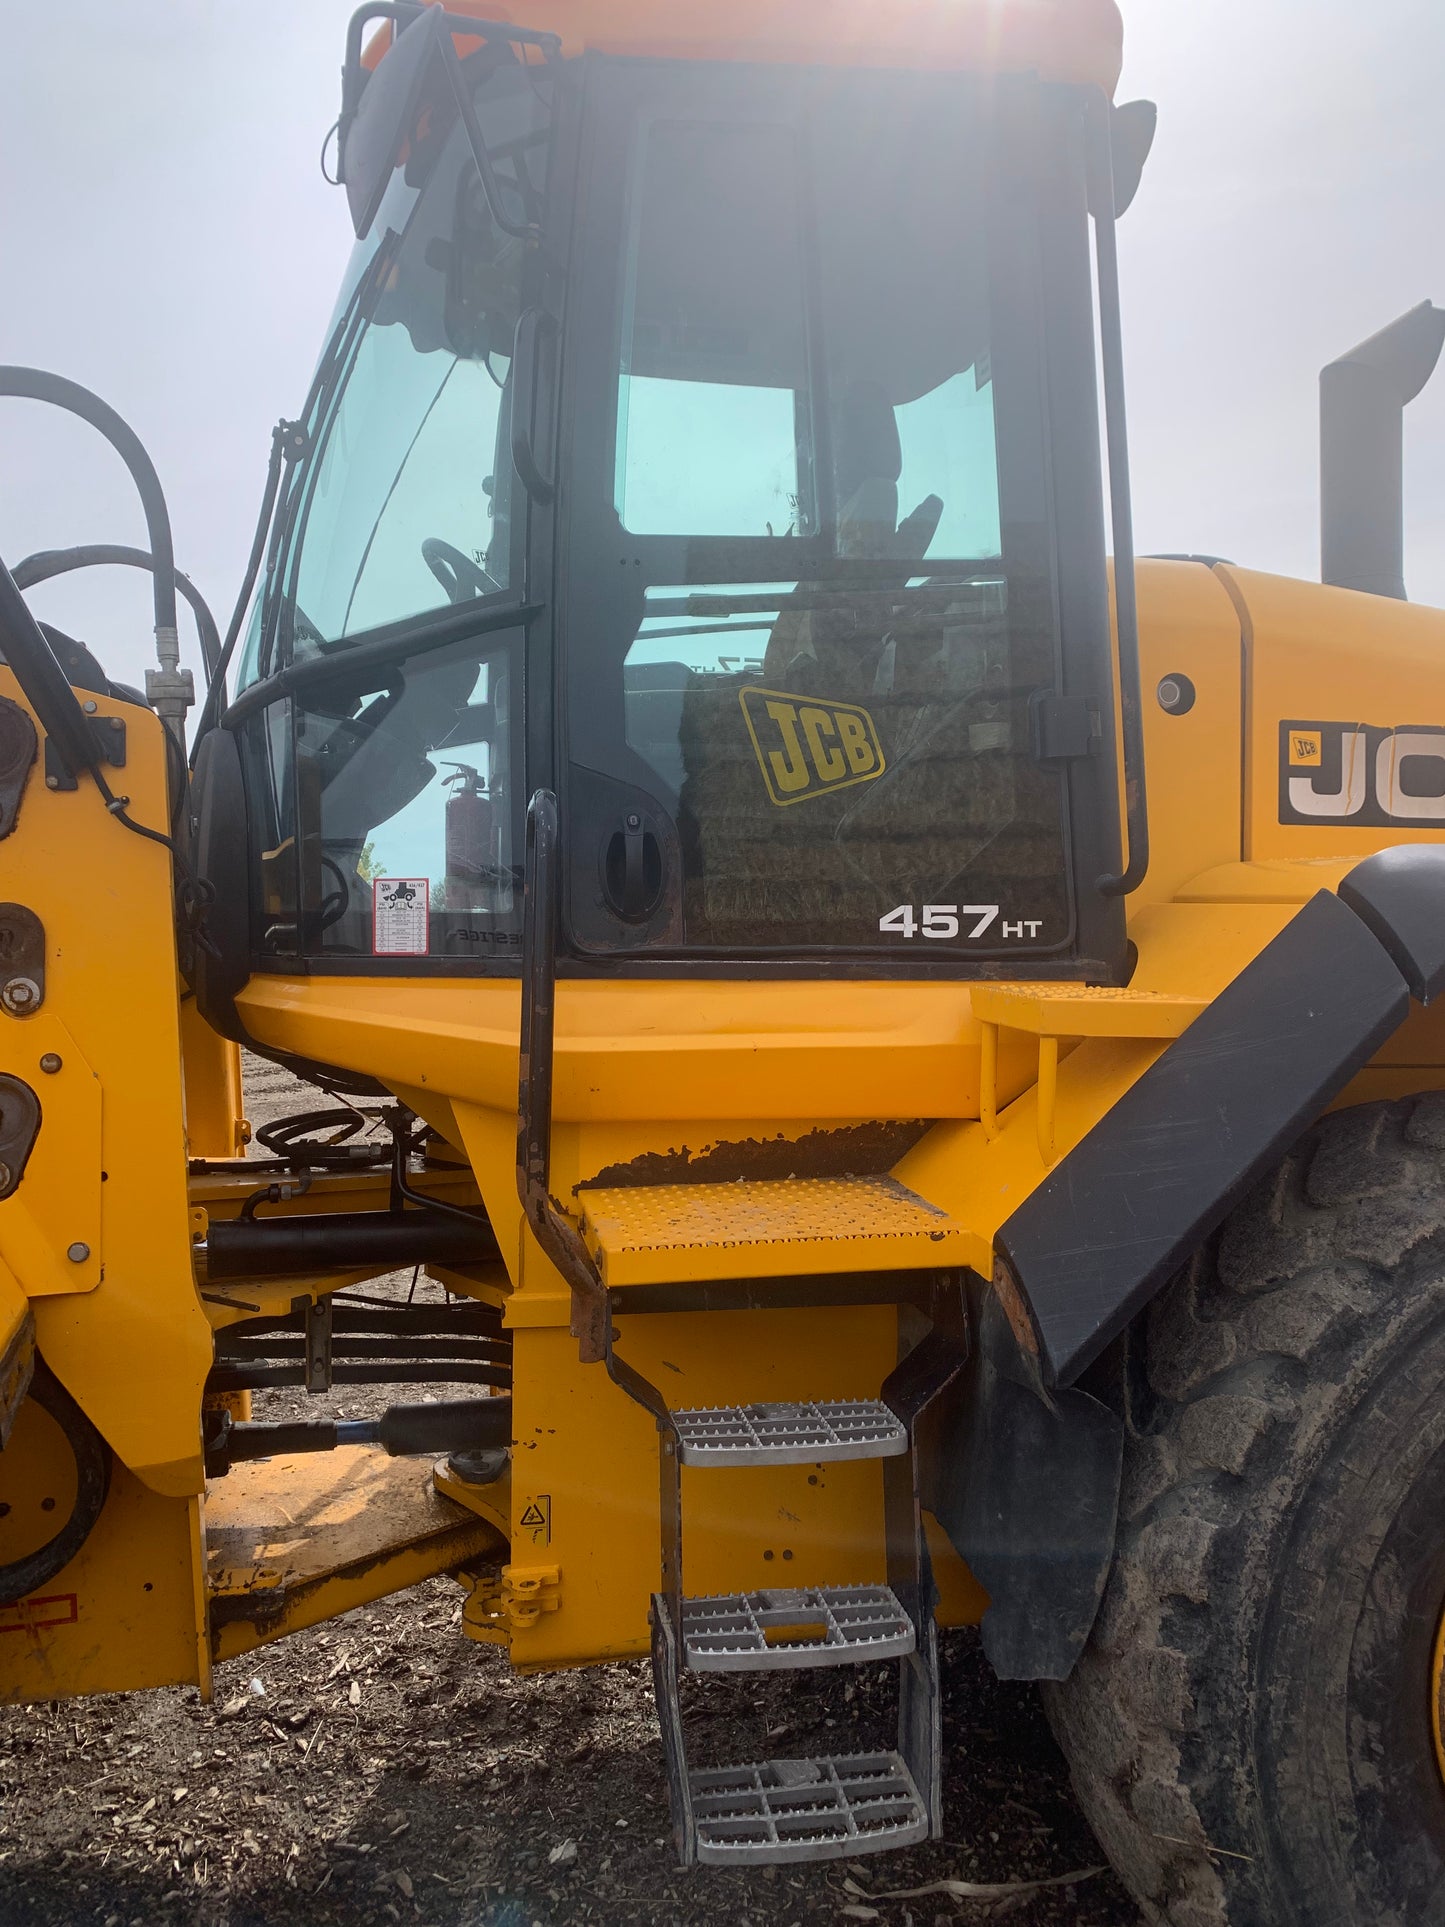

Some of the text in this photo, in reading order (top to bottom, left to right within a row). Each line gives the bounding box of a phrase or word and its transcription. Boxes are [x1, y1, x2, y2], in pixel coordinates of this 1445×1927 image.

[765, 700, 875, 793] JCB
[1297, 740, 1317, 757] JCB
[879, 904, 1043, 938] 457 HT
